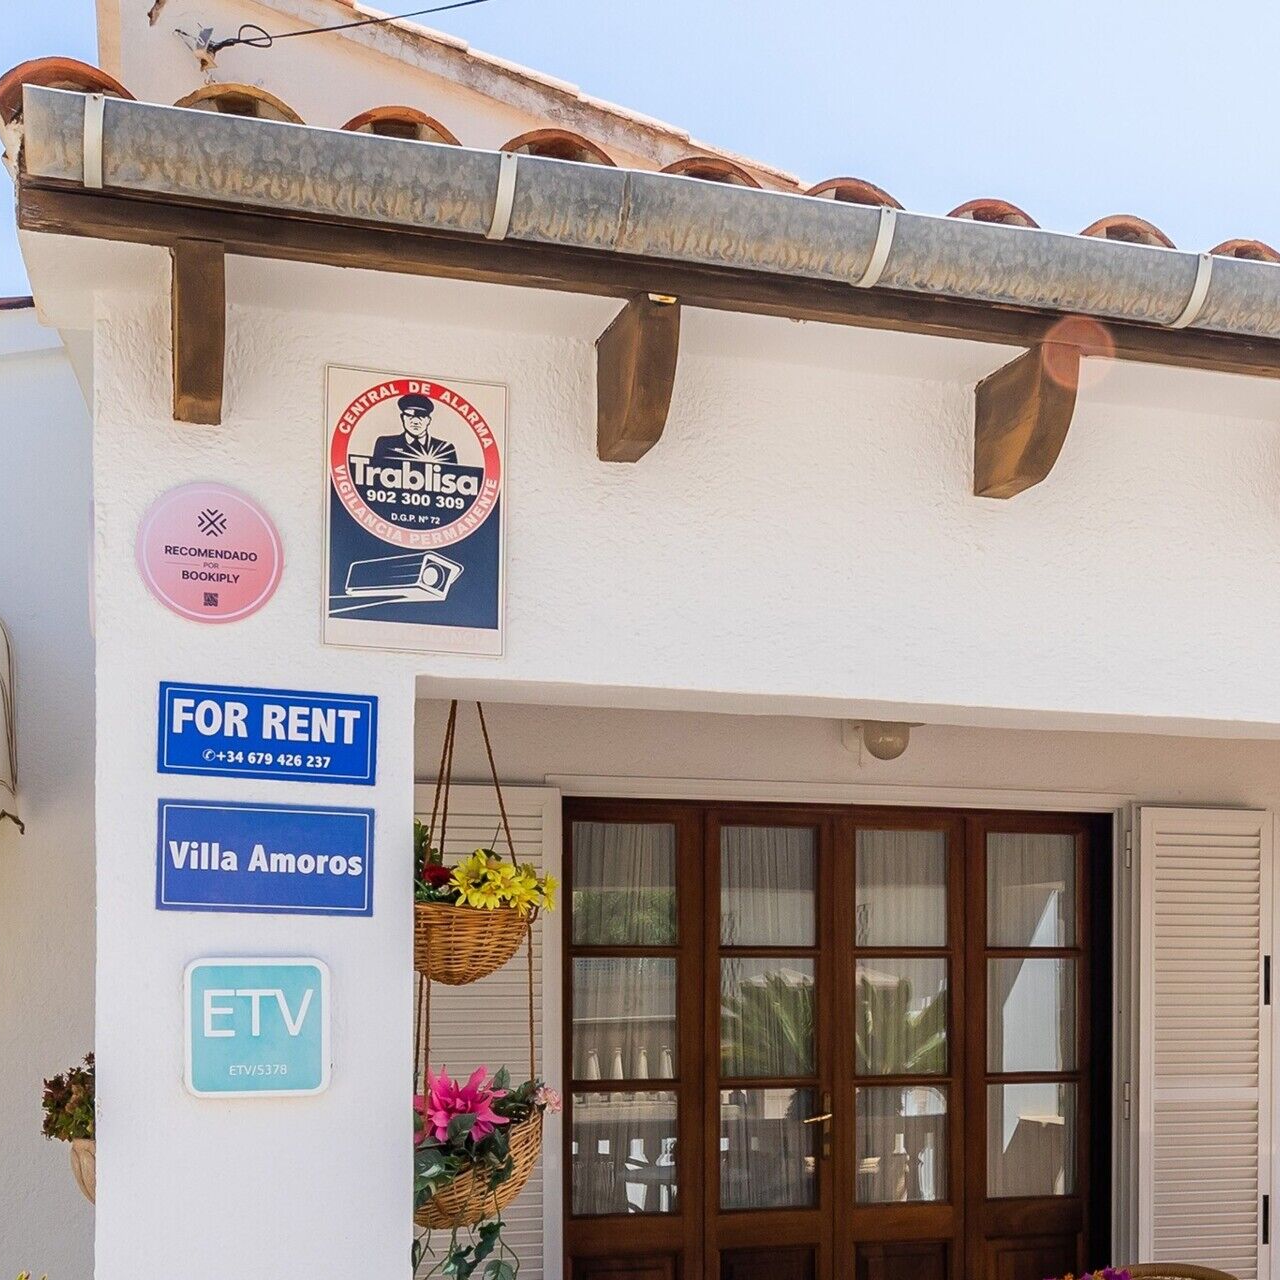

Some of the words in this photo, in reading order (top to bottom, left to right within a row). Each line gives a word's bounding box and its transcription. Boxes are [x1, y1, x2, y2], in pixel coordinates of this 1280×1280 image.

[337, 382, 400, 435] CENTRAL
[408, 380, 431, 396] DE
[439, 388, 493, 450] ALARMA
[350, 456, 478, 497] Trablisa
[333, 463, 404, 545] VIGILANCIA
[408, 477, 499, 547] PERMANENTE
[366, 489, 397, 504] 902
[401, 492, 431, 507] 300
[435, 495, 465, 510] 309
[391, 512, 417, 523] D.G.P.
[430, 516, 441, 525] 72
[164, 545, 258, 562] RECOMENDADO
[203, 561, 219, 570] POR
[181, 569, 240, 584] BOOKIPLY
[172, 698, 249, 738] FOR
[262, 703, 362, 745] RENT
[247, 751, 273, 765] 679
[276, 753, 302, 767] 426
[306, 755, 331, 769] 237
[169, 840, 238, 872] Villa
[247, 844, 363, 876] Amoros
[203, 988, 314, 1038] ETV
